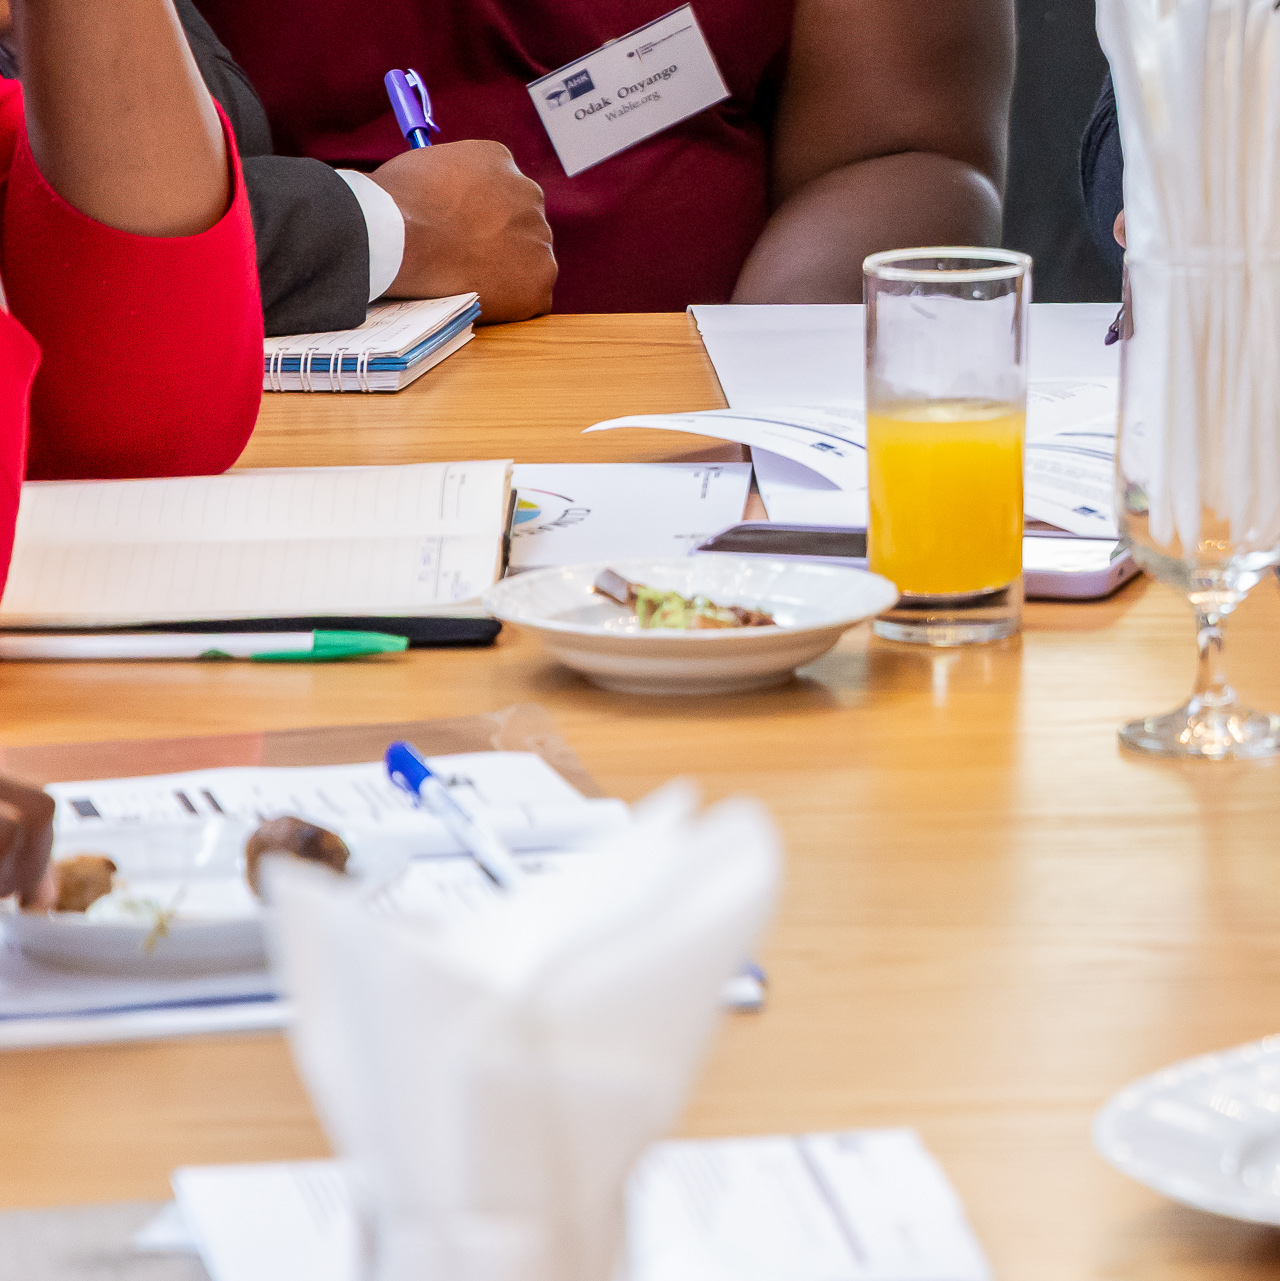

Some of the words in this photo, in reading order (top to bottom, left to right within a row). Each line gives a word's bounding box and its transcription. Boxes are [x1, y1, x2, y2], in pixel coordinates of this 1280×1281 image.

[574, 96, 612, 121] Odak
[616, 64, 678, 99] Onyango
[604, 91, 661, 122] Wable.org
